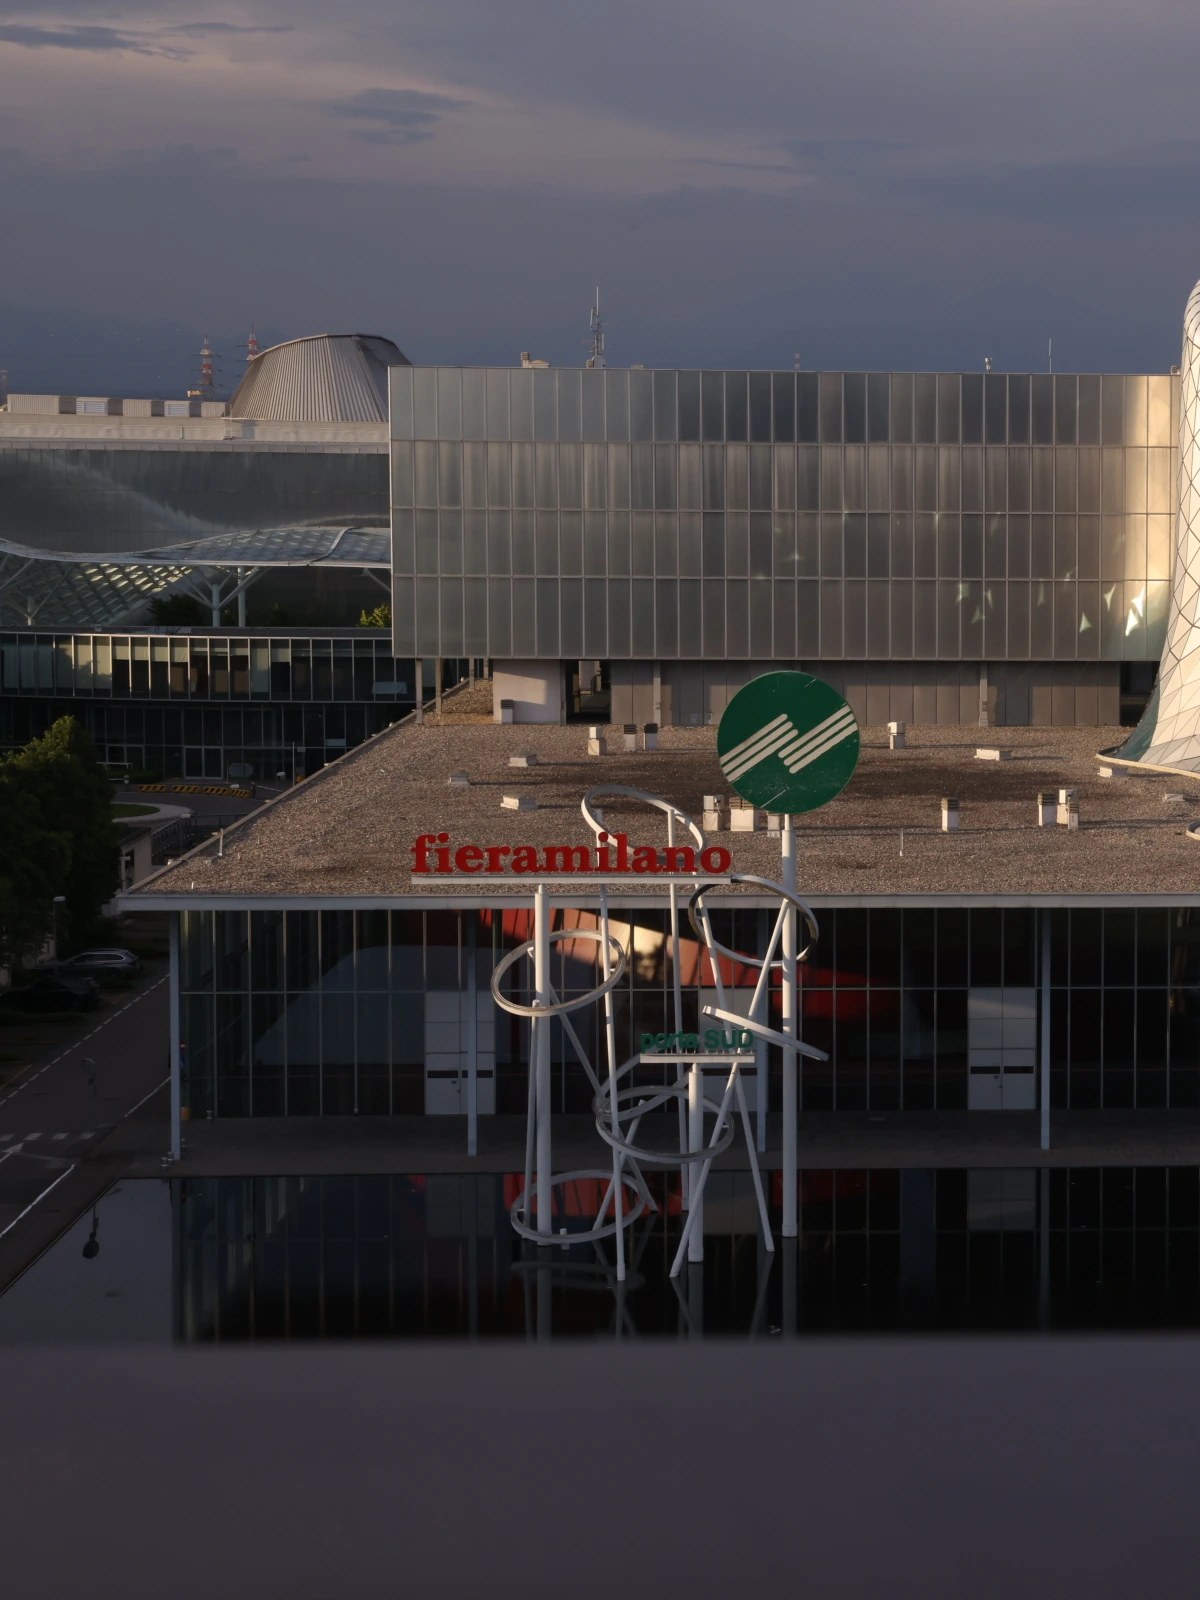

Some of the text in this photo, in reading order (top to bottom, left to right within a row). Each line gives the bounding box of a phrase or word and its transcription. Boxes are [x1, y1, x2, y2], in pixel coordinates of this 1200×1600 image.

[410, 831, 732, 874] fieramilano
[640, 1028, 754, 1053] porta SUD
